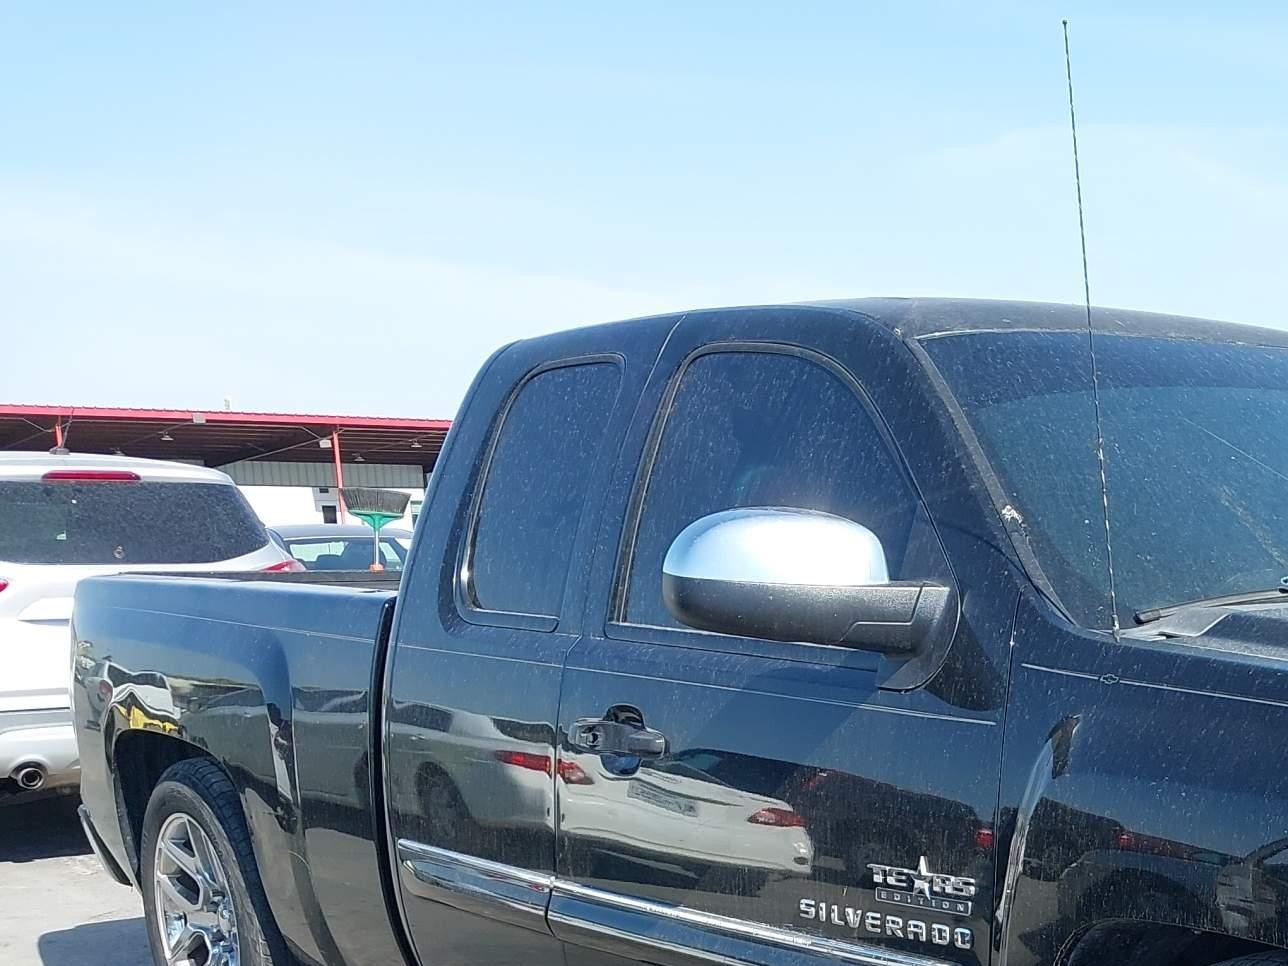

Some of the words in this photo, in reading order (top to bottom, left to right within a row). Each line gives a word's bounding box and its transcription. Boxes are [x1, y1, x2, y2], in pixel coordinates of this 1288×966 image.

[866, 856, 976, 897] TEXAS
[880, 891, 966, 912] EDITION
[799, 898, 973, 950] SILVERADO
